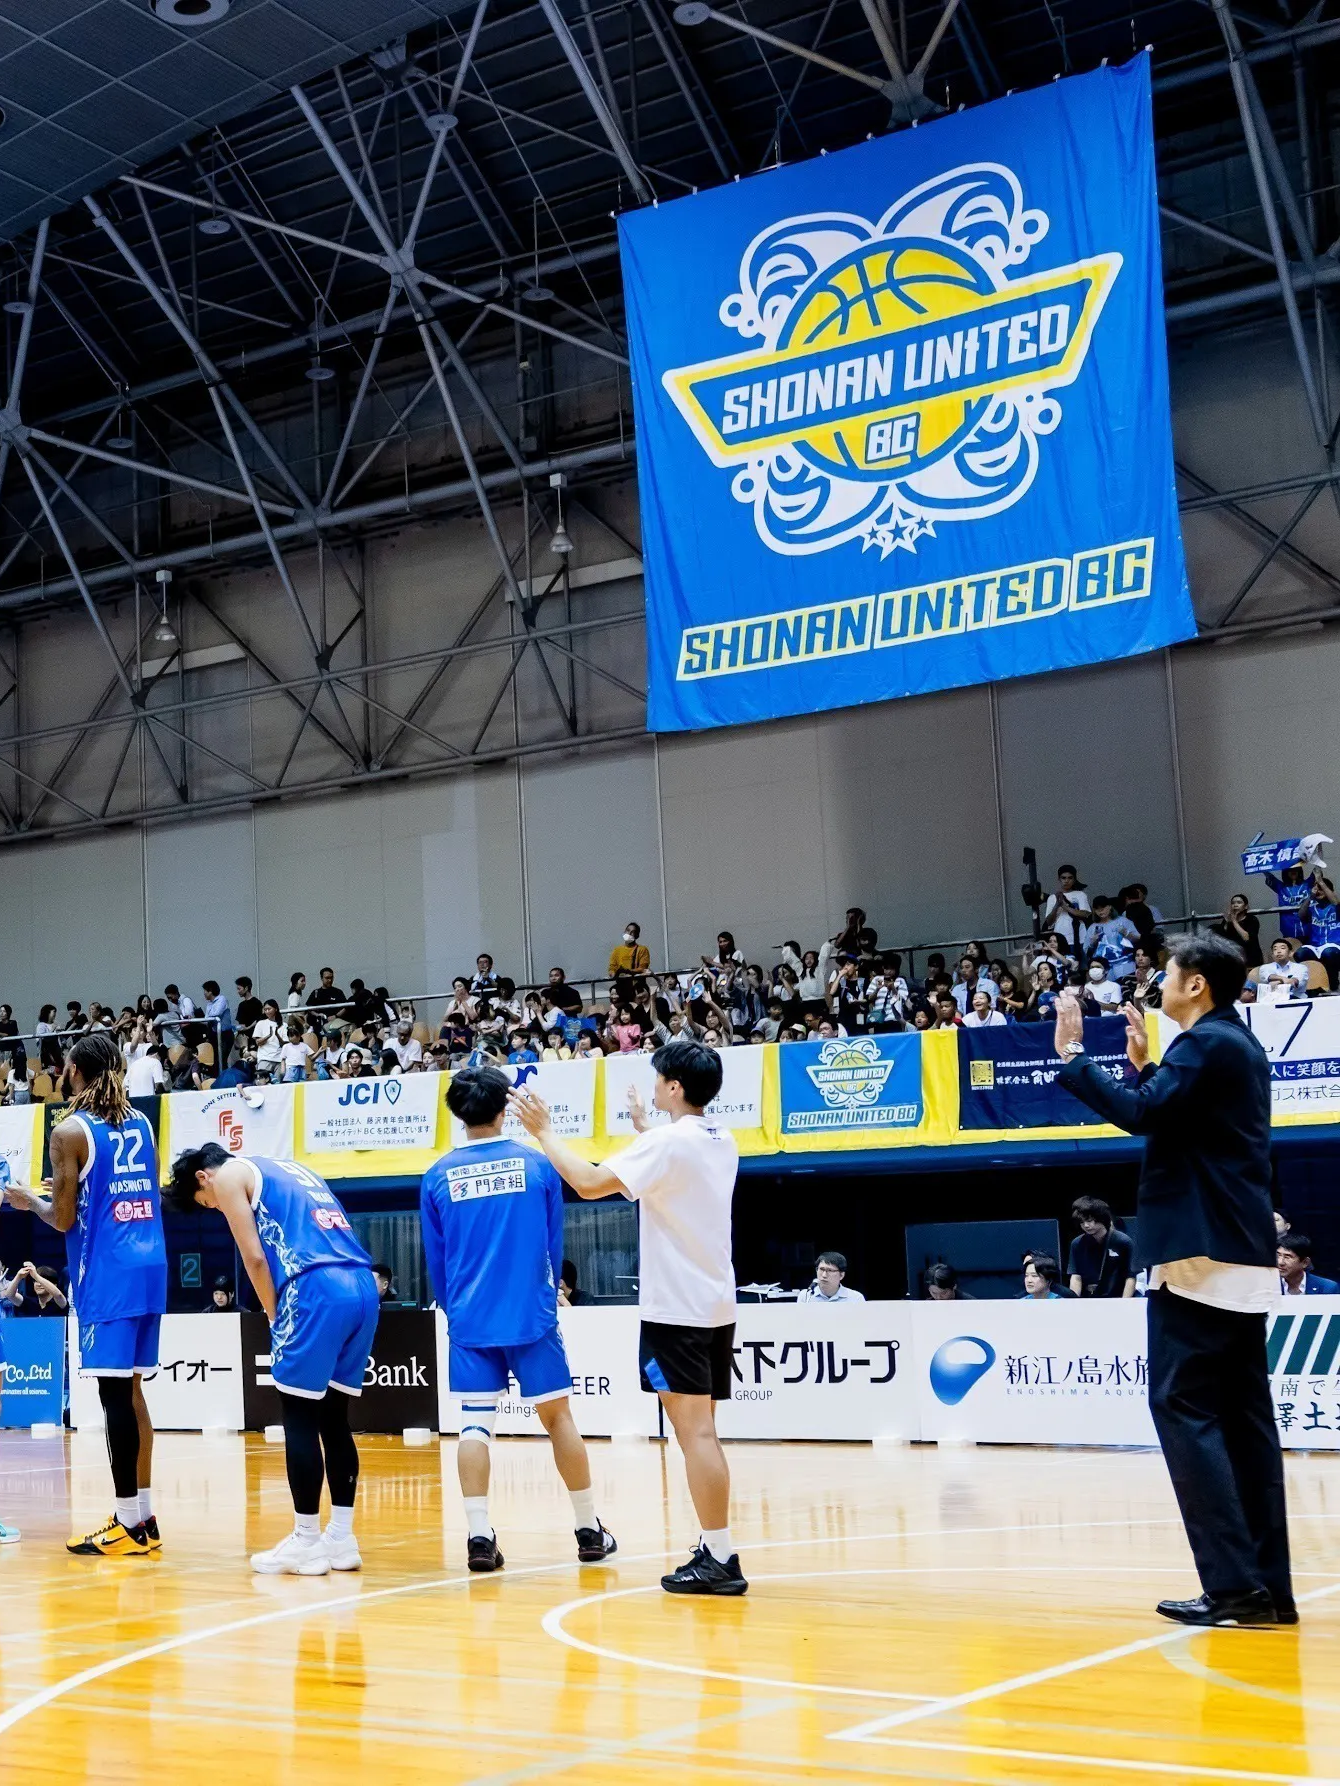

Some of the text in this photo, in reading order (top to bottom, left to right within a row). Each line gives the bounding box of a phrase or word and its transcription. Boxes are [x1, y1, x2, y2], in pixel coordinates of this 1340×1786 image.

[722, 303, 1071, 435] SHONAN UNITED
[866, 415, 920, 463] BC
[680, 543, 1149, 677] SHONAN UNITED BC
[818, 1067, 885, 1081] SHONAN UNITED
[201, 1098, 216, 1114] BONE
[216, 1092, 237, 1101] SETTER
[338, 1083, 380, 1106] JCI
[789, 1105, 916, 1127] SHONAN UNITED BC
[108, 1128, 147, 1175] 22
[475, 1173, 524, 1195] 門倉組
[183, 1258, 199, 1282] 2
[5, 1362, 53, 1383] Co.,Ltd
[735, 1390, 773, 1401] GROUP
[1006, 1388, 1146, 1397] ENOSHIMA AQUA
[496, 1402, 538, 1418] oldings
